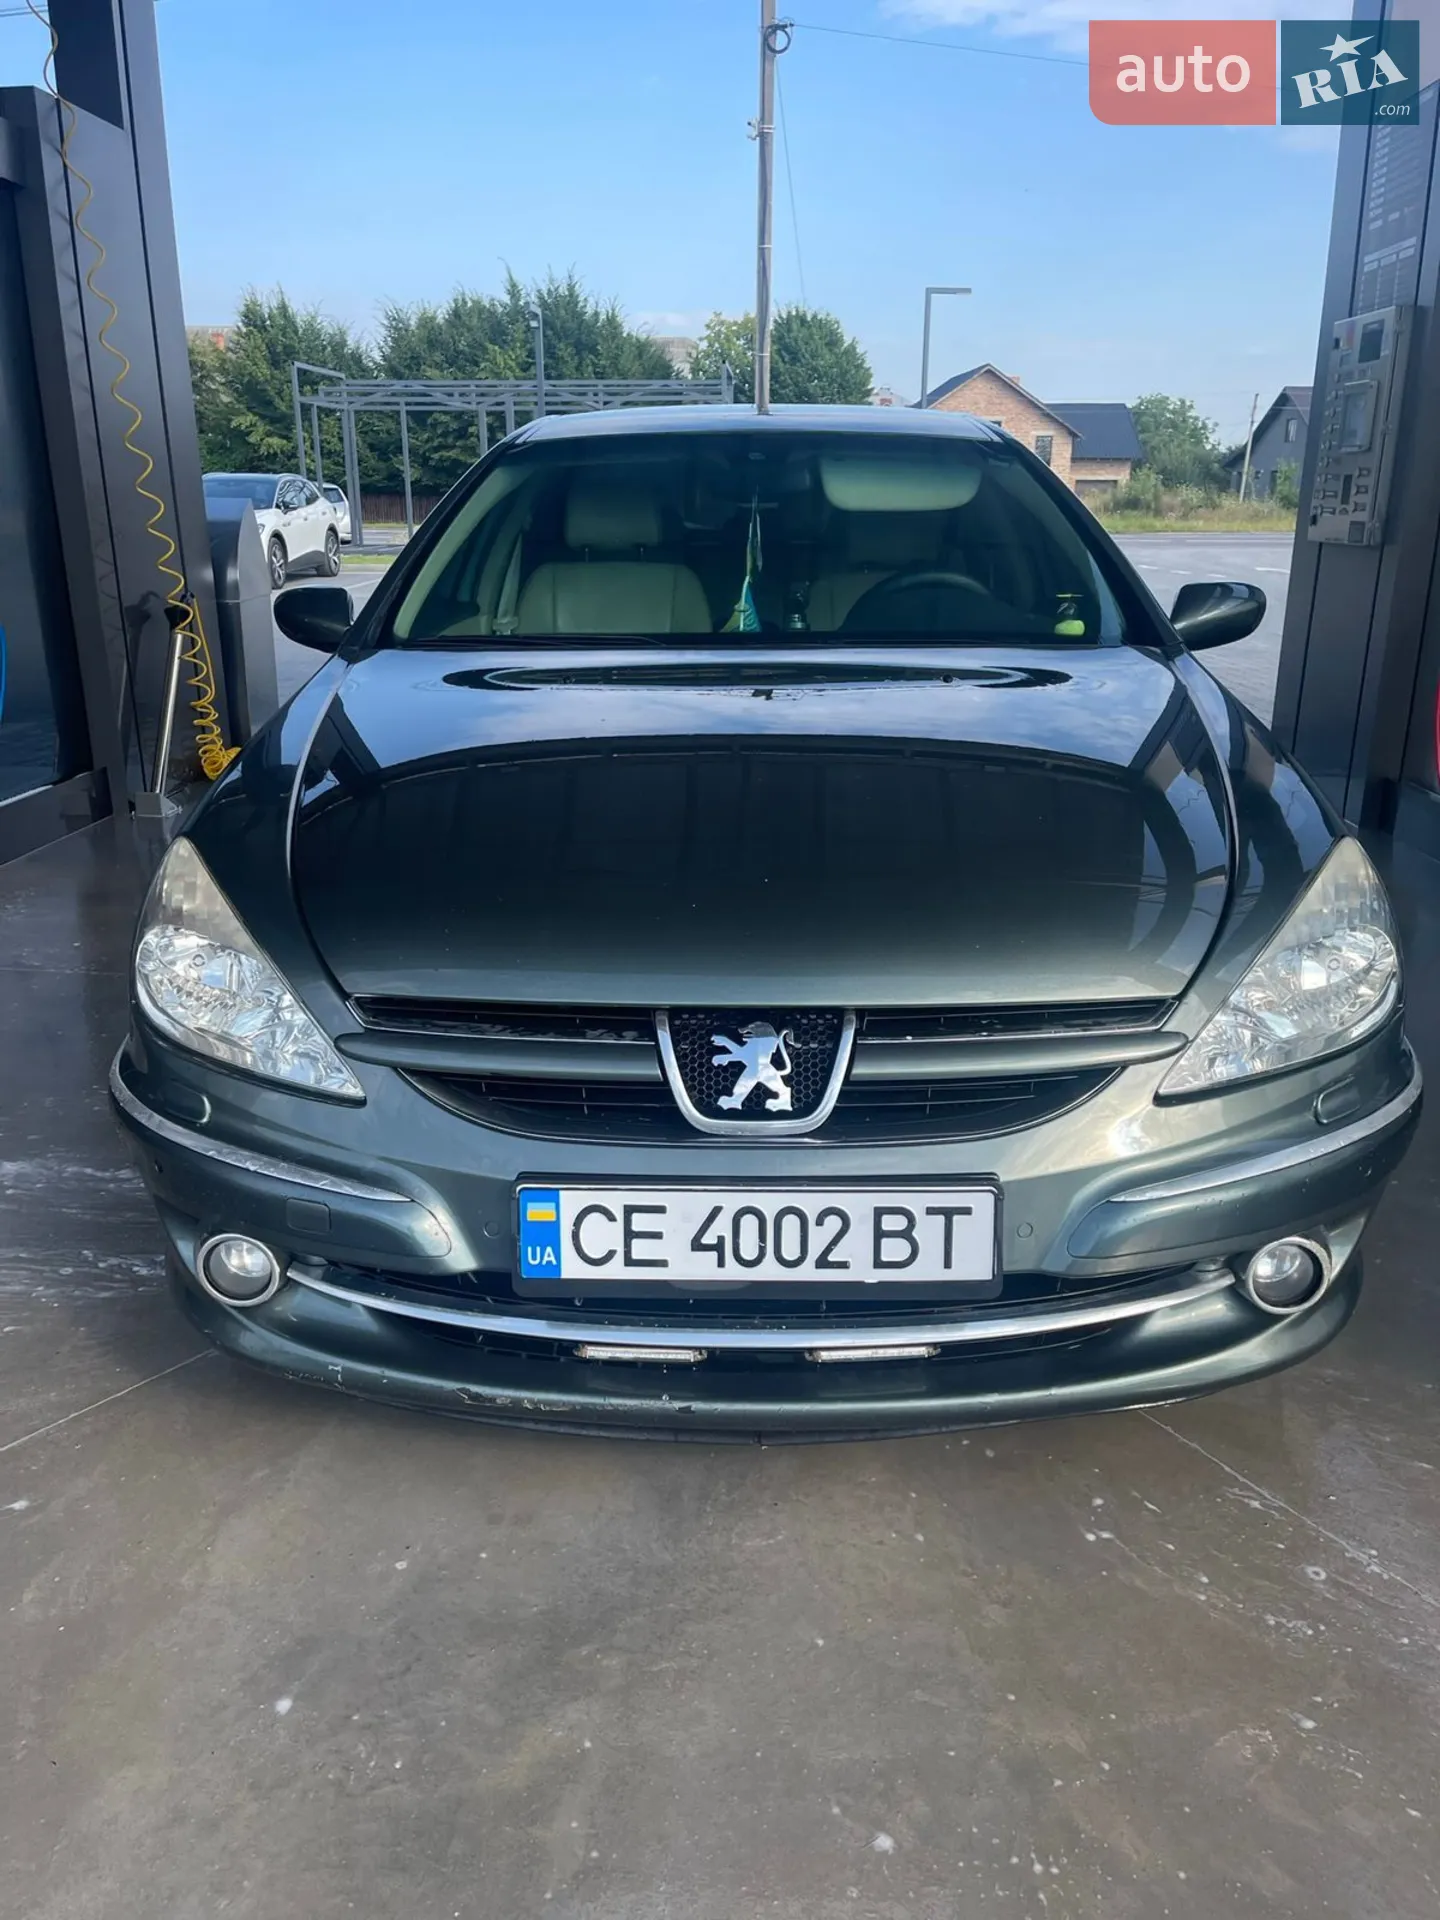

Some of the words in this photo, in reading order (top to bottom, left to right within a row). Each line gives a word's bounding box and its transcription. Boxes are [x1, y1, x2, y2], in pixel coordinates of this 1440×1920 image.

[527, 1246, 557, 1266] UA
[571, 1204, 669, 1268] CE
[690, 1204, 851, 1269] 4002
[872, 1205, 973, 1270] BT
